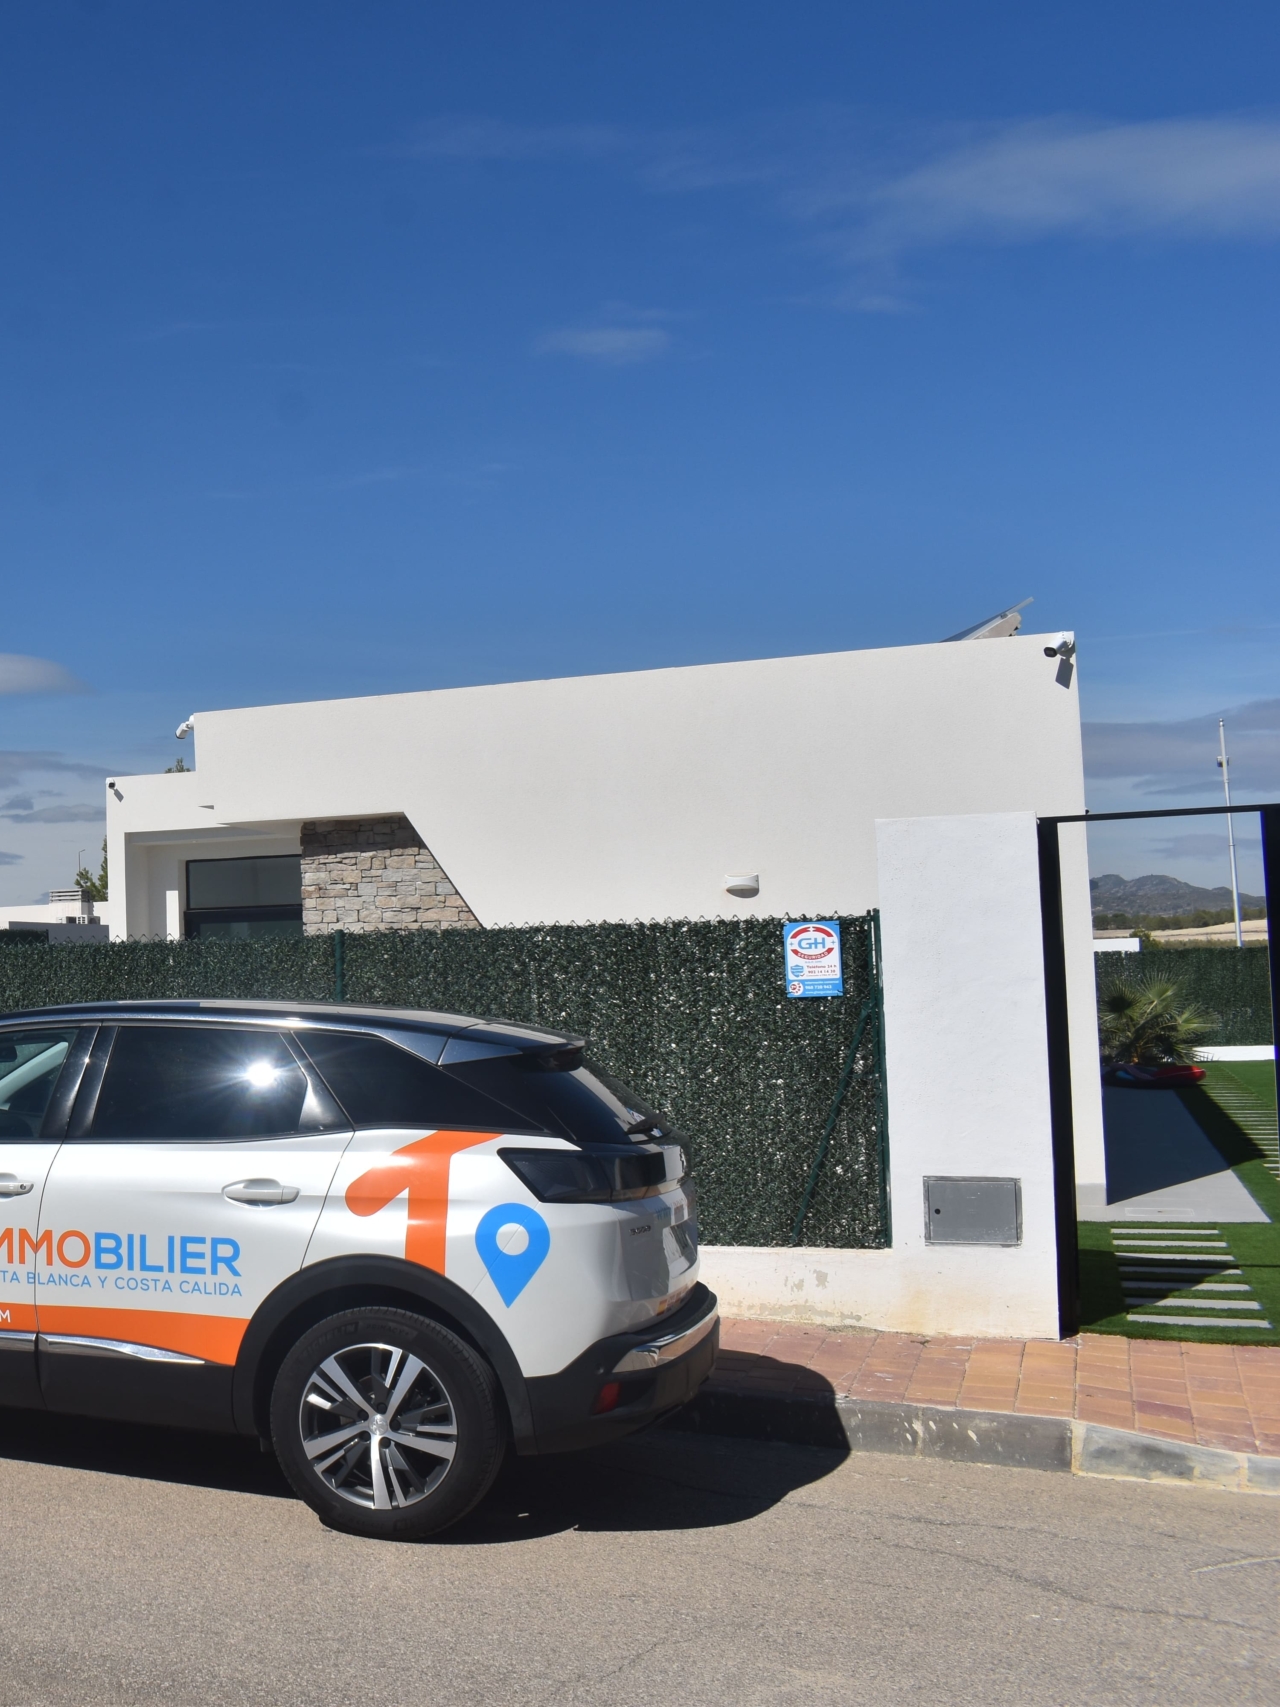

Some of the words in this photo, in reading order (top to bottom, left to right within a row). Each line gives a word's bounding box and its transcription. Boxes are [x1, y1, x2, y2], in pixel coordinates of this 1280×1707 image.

[798, 937, 826, 949] GH
[797, 951, 829, 960] SEGURIDAD
[26, 1271, 92, 1288] BLANCA
[97, 1276, 108, 1289] Y
[114, 1276, 173, 1293] COSTA
[179, 1280, 243, 1297] CALIDA
